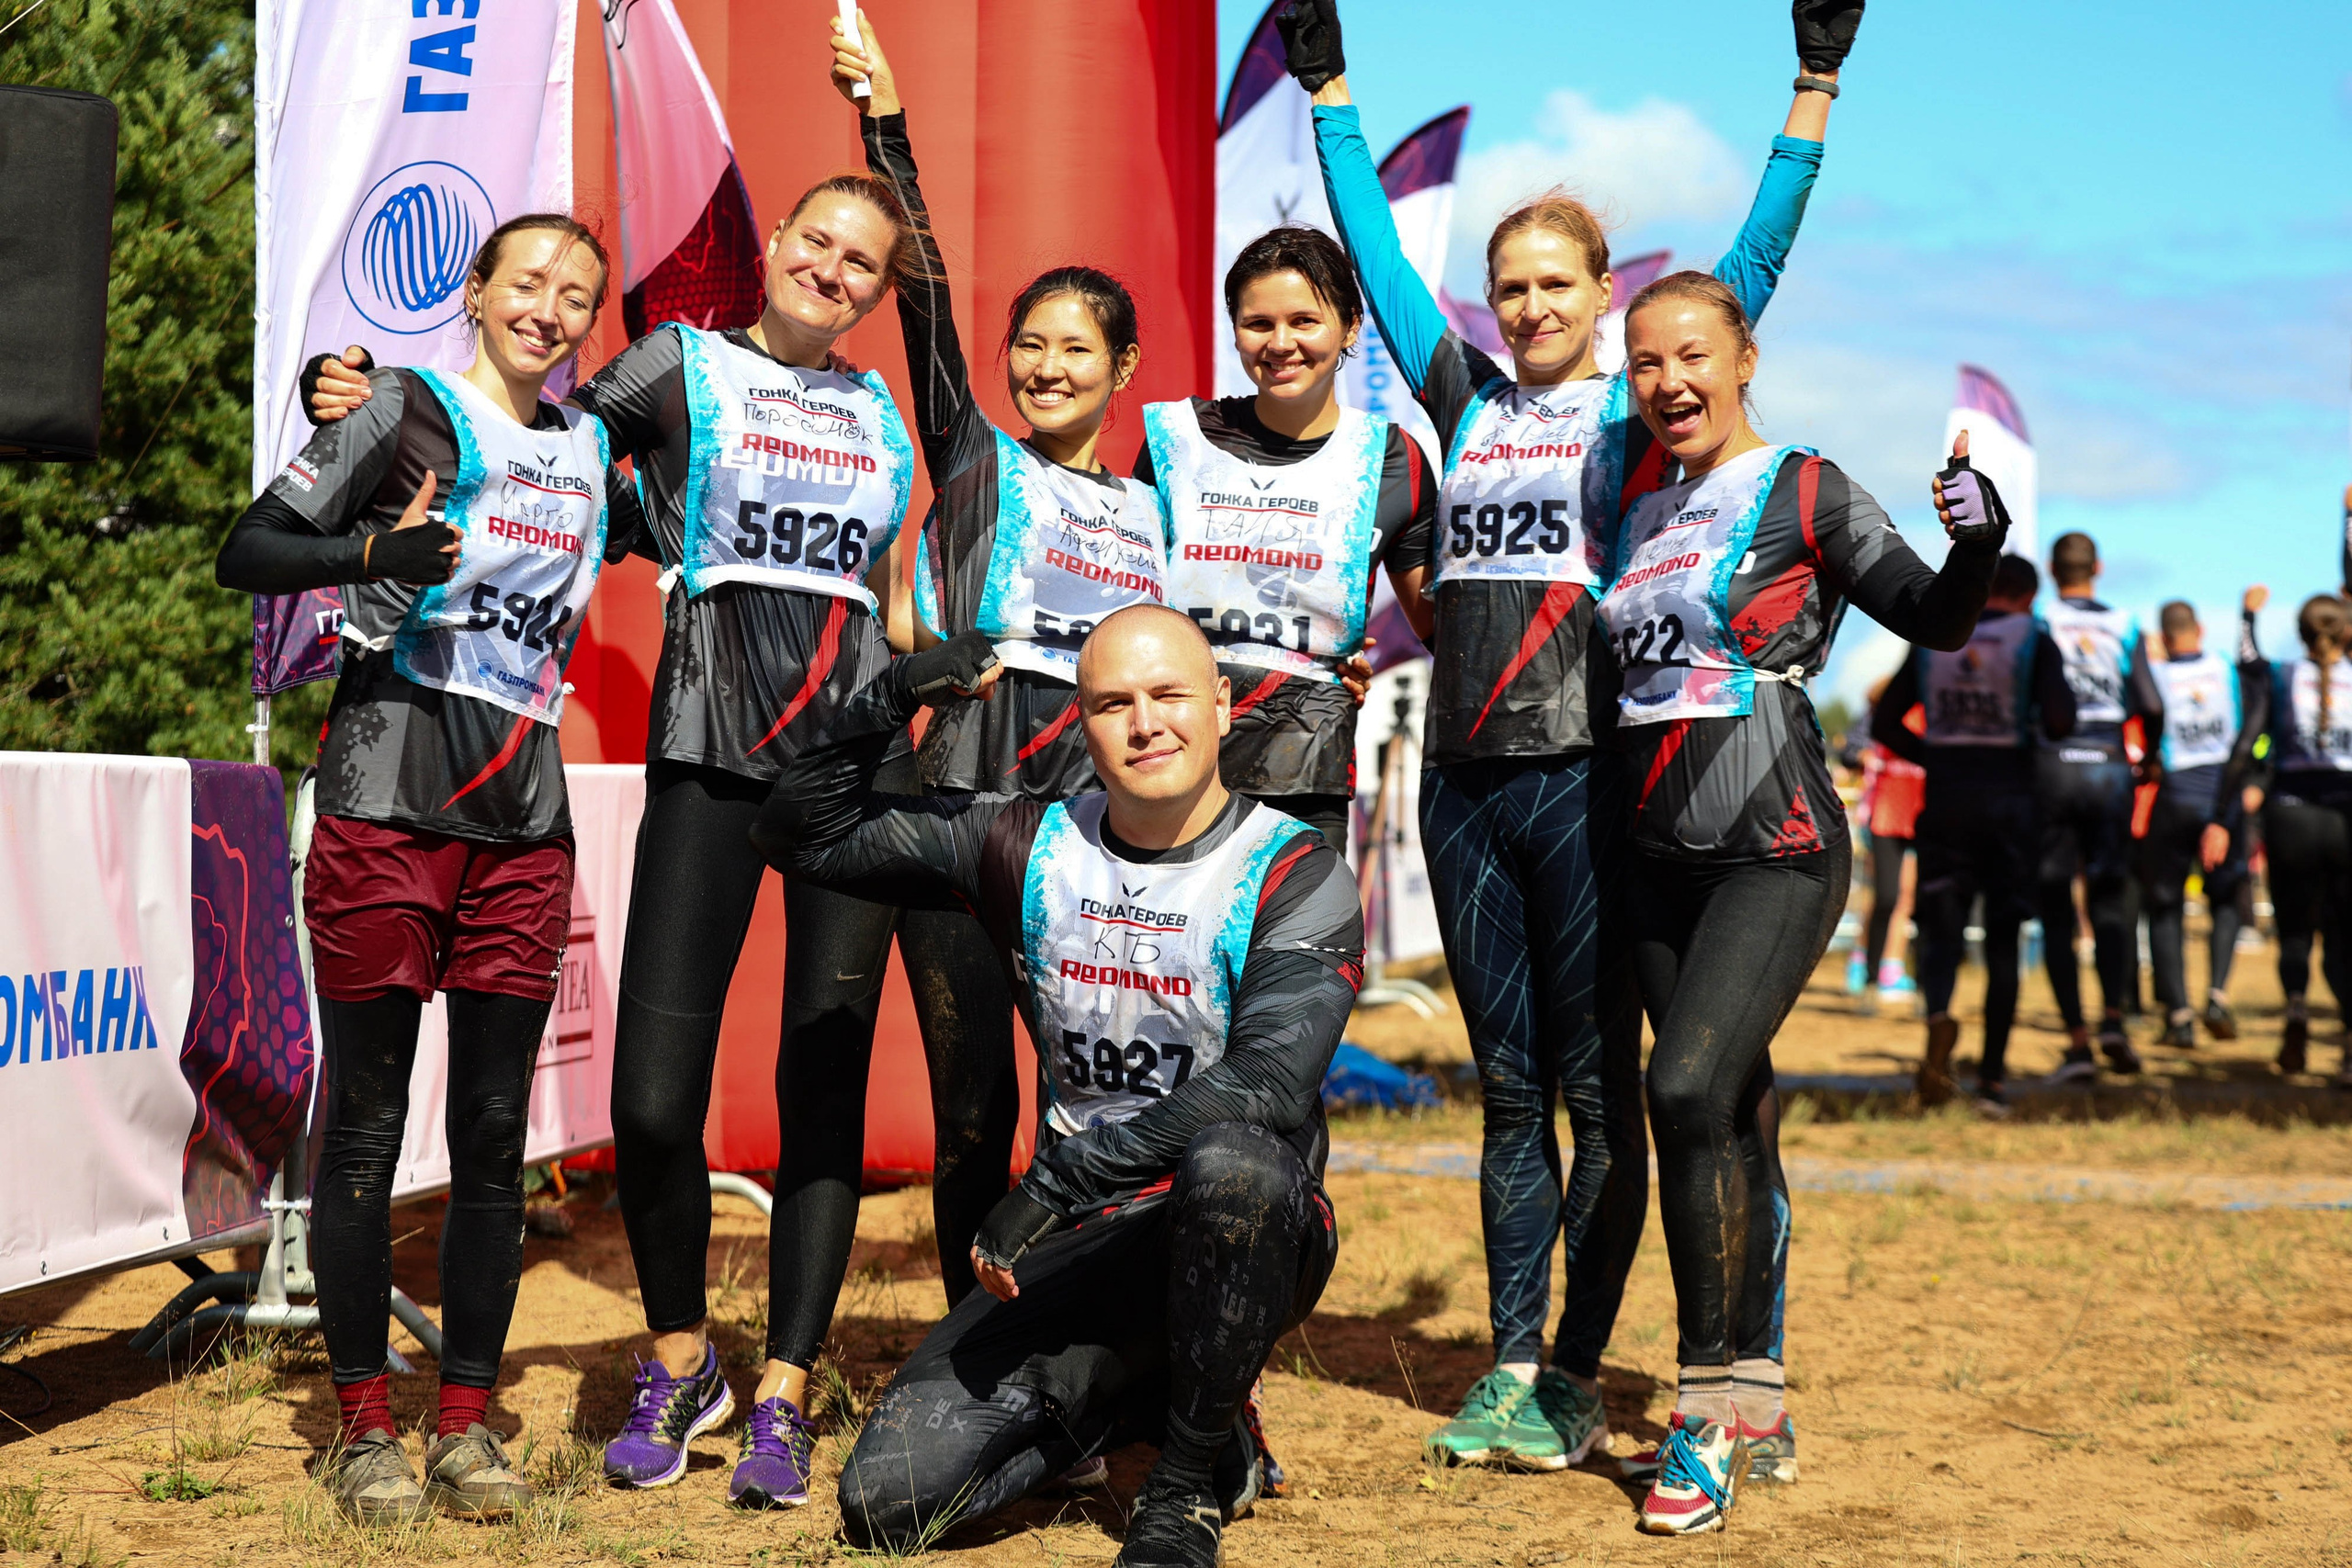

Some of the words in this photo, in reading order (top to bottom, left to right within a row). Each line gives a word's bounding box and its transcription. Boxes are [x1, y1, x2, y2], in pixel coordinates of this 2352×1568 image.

[748, 387, 799, 405] ГОНКА
[802, 399, 857, 421] ГЕРОЕВ
[507, 459, 542, 486] ГОНКА
[545, 474, 593, 495] ГЕРОЕВ
[1200, 491, 1253, 508] ГОНКА
[1259, 496, 1319, 513] ГЕРОЕВ
[734, 500, 868, 574] 5926
[1060, 507, 1108, 529] ГОНКА
[1112, 519, 1153, 548] ГЕРОЕВ
[1451, 499, 1570, 558] 5925
[1129, 906, 1188, 928] ГЕРОЕВ
[1062, 1029, 1194, 1099] 5927
